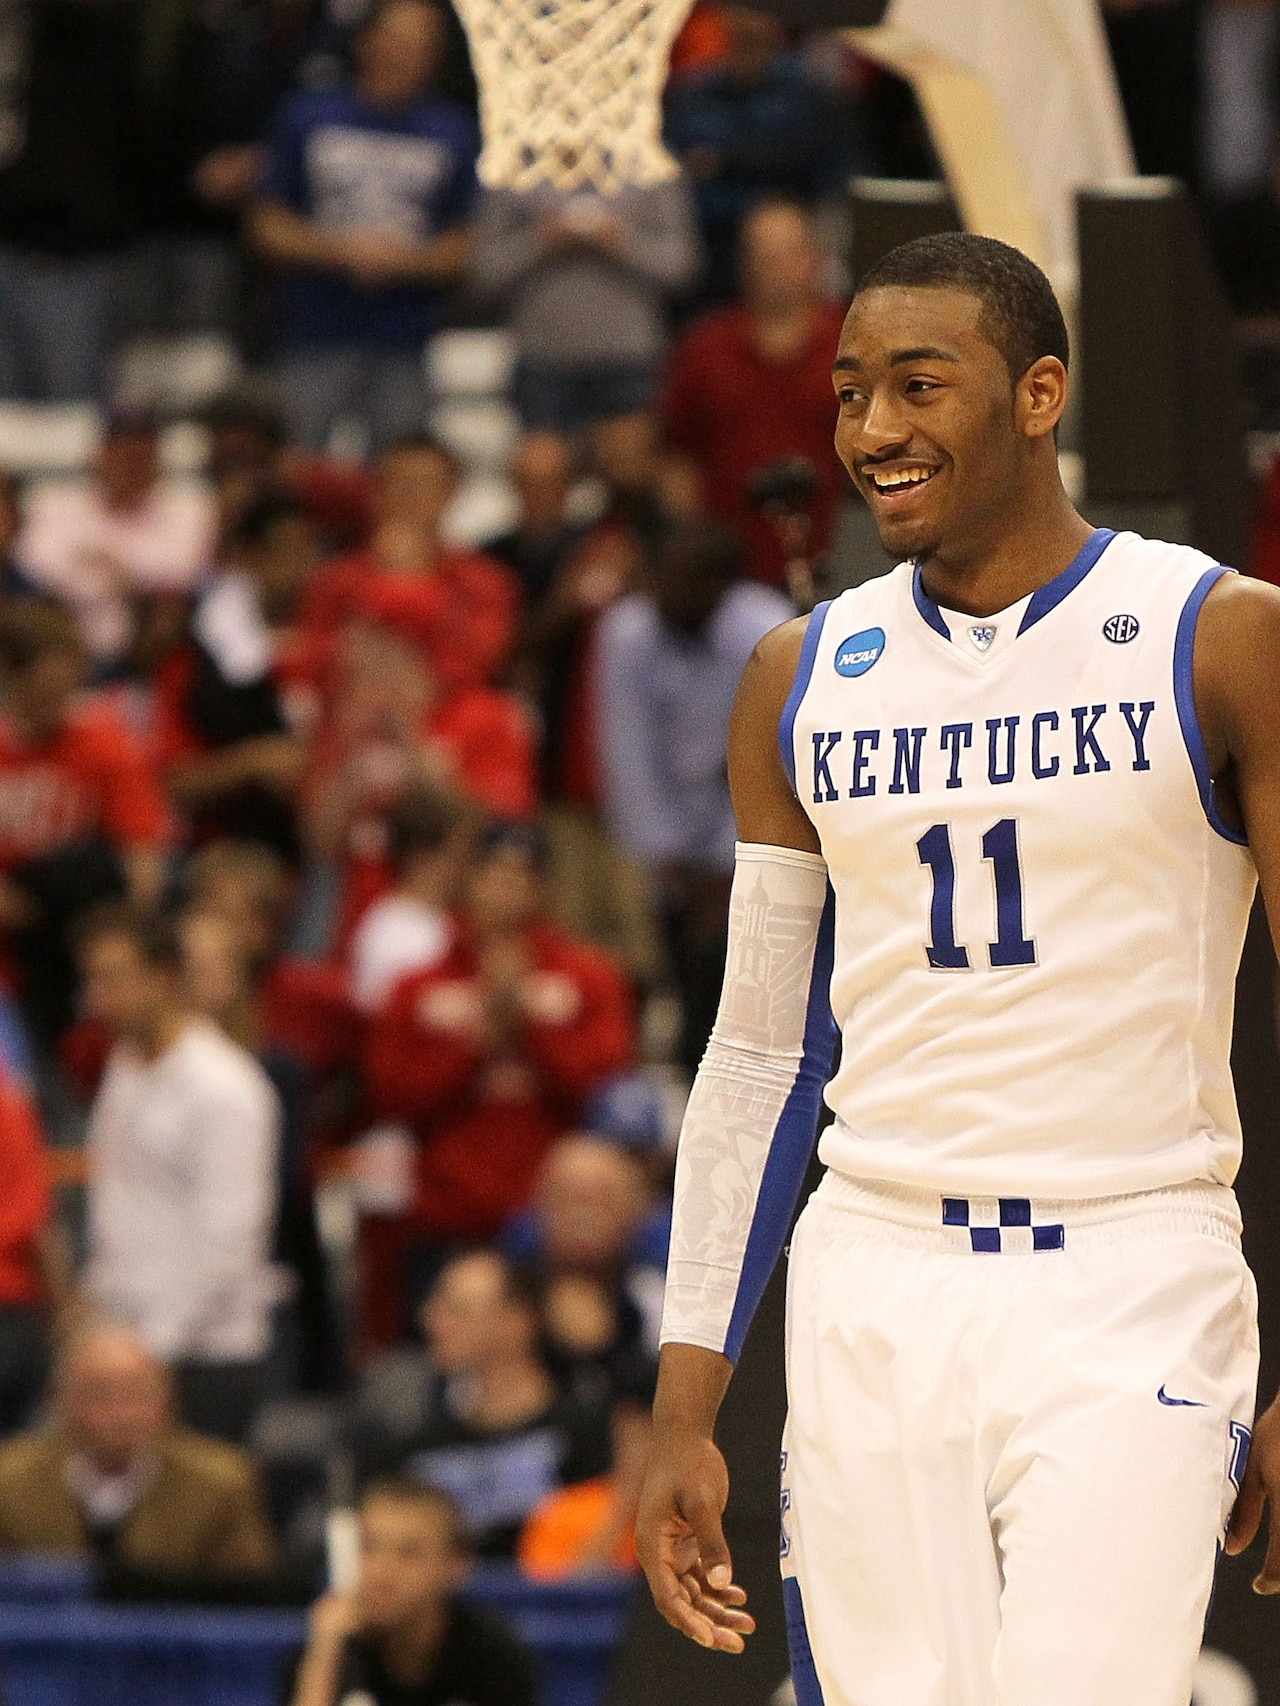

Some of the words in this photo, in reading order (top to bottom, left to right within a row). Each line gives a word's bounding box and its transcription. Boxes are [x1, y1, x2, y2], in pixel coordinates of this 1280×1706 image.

[838, 647, 879, 667] NCAA
[1104, 615, 1138, 642] SEC
[811, 700, 1155, 804] KENTUCKY
[914, 816, 1040, 973] 11
